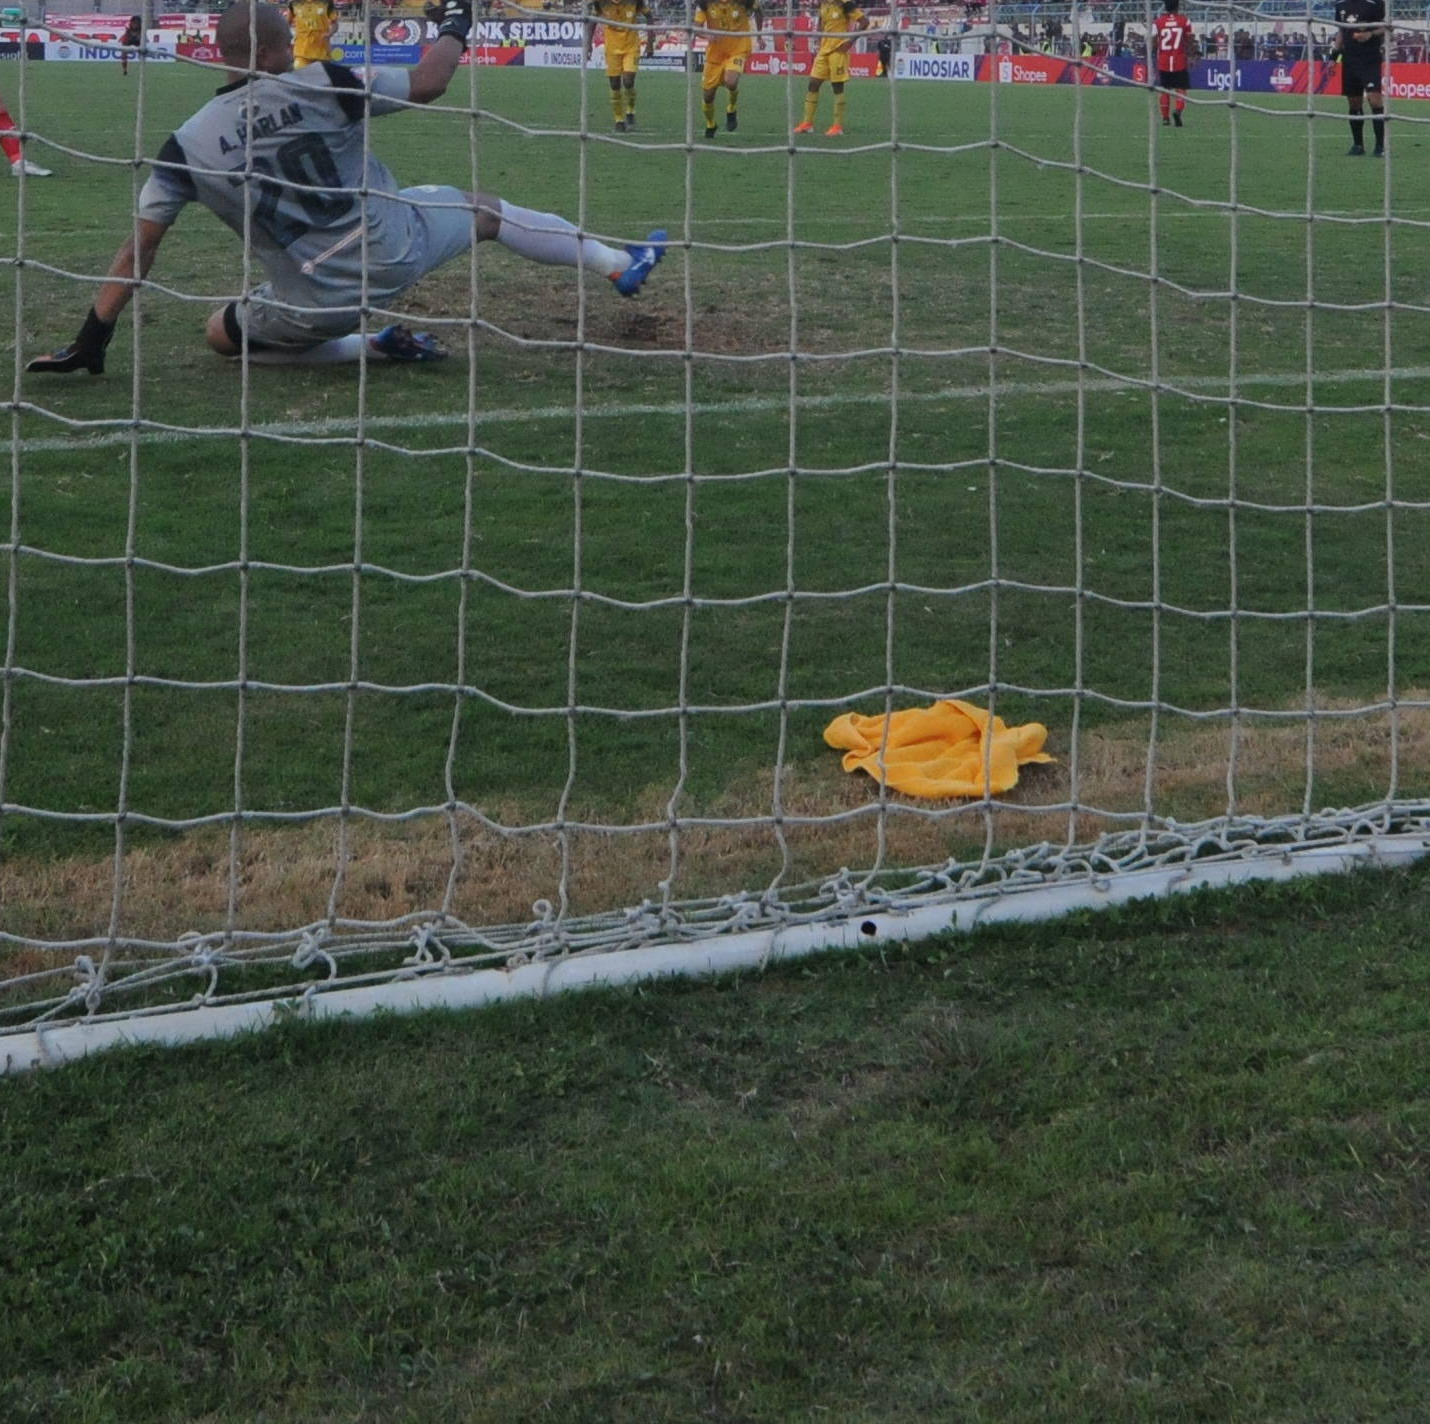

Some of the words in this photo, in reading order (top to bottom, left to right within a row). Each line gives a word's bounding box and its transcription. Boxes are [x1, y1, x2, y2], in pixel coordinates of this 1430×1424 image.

[1160, 27, 1183, 51] 27
[909, 59, 970, 78] INDOSIAR
[1013, 65, 1048, 83] Shopee
